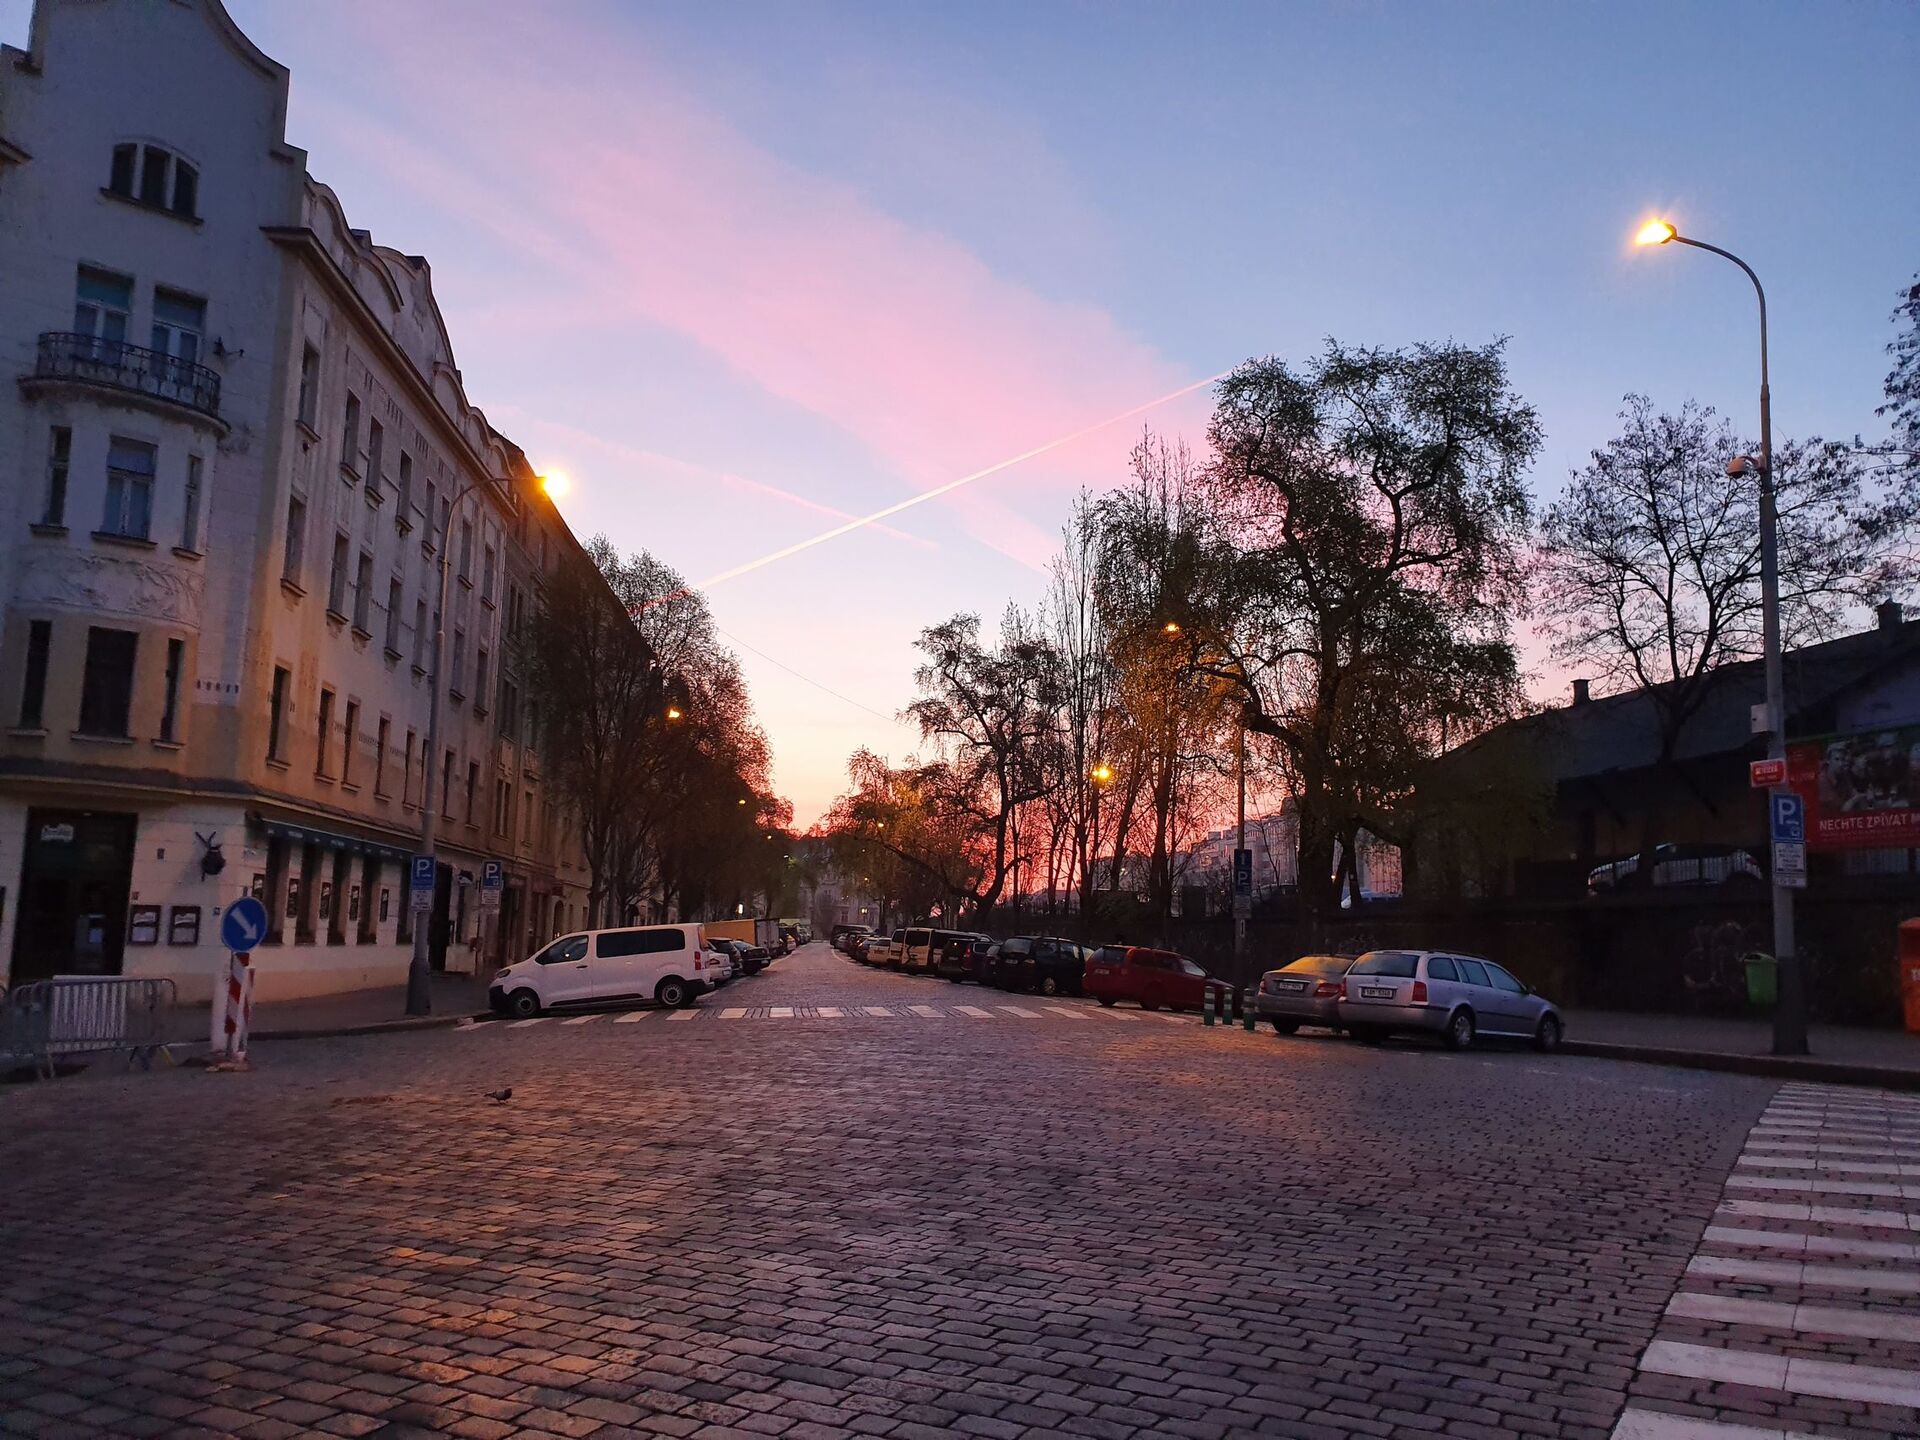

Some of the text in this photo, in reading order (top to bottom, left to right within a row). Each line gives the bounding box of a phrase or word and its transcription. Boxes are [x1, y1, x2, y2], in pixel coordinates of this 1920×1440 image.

[1778, 798, 1796, 825] P
[1819, 816, 1863, 831] NECHTE
[1866, 812, 1908, 829] ZPÍVAT
[416, 859, 430, 877] P
[486, 863, 498, 879] P
[1237, 870, 1248, 885] P
